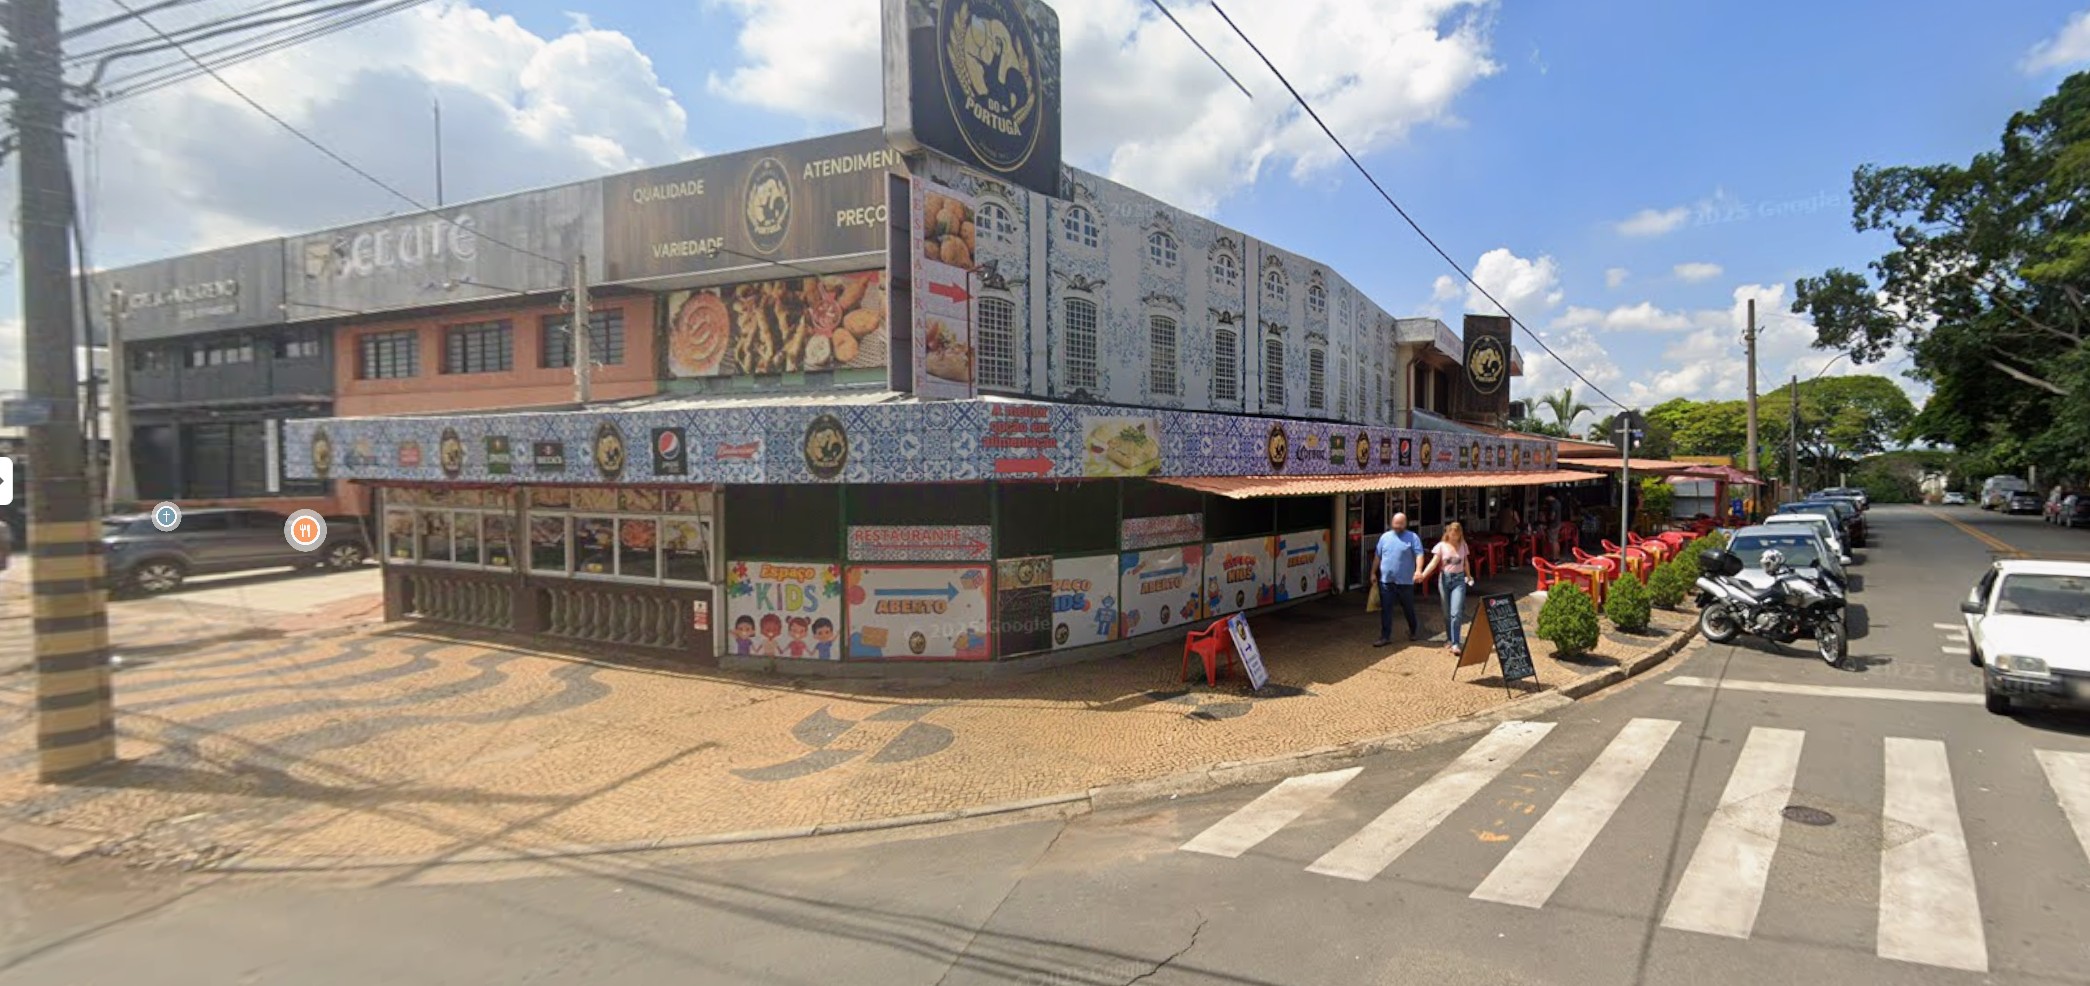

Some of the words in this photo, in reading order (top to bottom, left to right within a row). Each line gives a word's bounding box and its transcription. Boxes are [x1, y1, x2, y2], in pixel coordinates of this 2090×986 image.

[988, 98, 1000, 113] DO
[965, 97, 1022, 136] PORTUGA
[633, 180, 704, 203] QUALIDADE
[836, 204, 887, 232] PREÇO
[652, 237, 724, 258] VARIEDADE
[1004, 404, 1048, 418] melhor
[1030, 422, 1051, 433] em
[981, 435, 1058, 449] alimentação
[854, 529, 962, 543] RESTAURANTE
[759, 563, 817, 583] Espaço
[755, 582, 819, 612] KIDS
[875, 599, 949, 615] ABERTO
